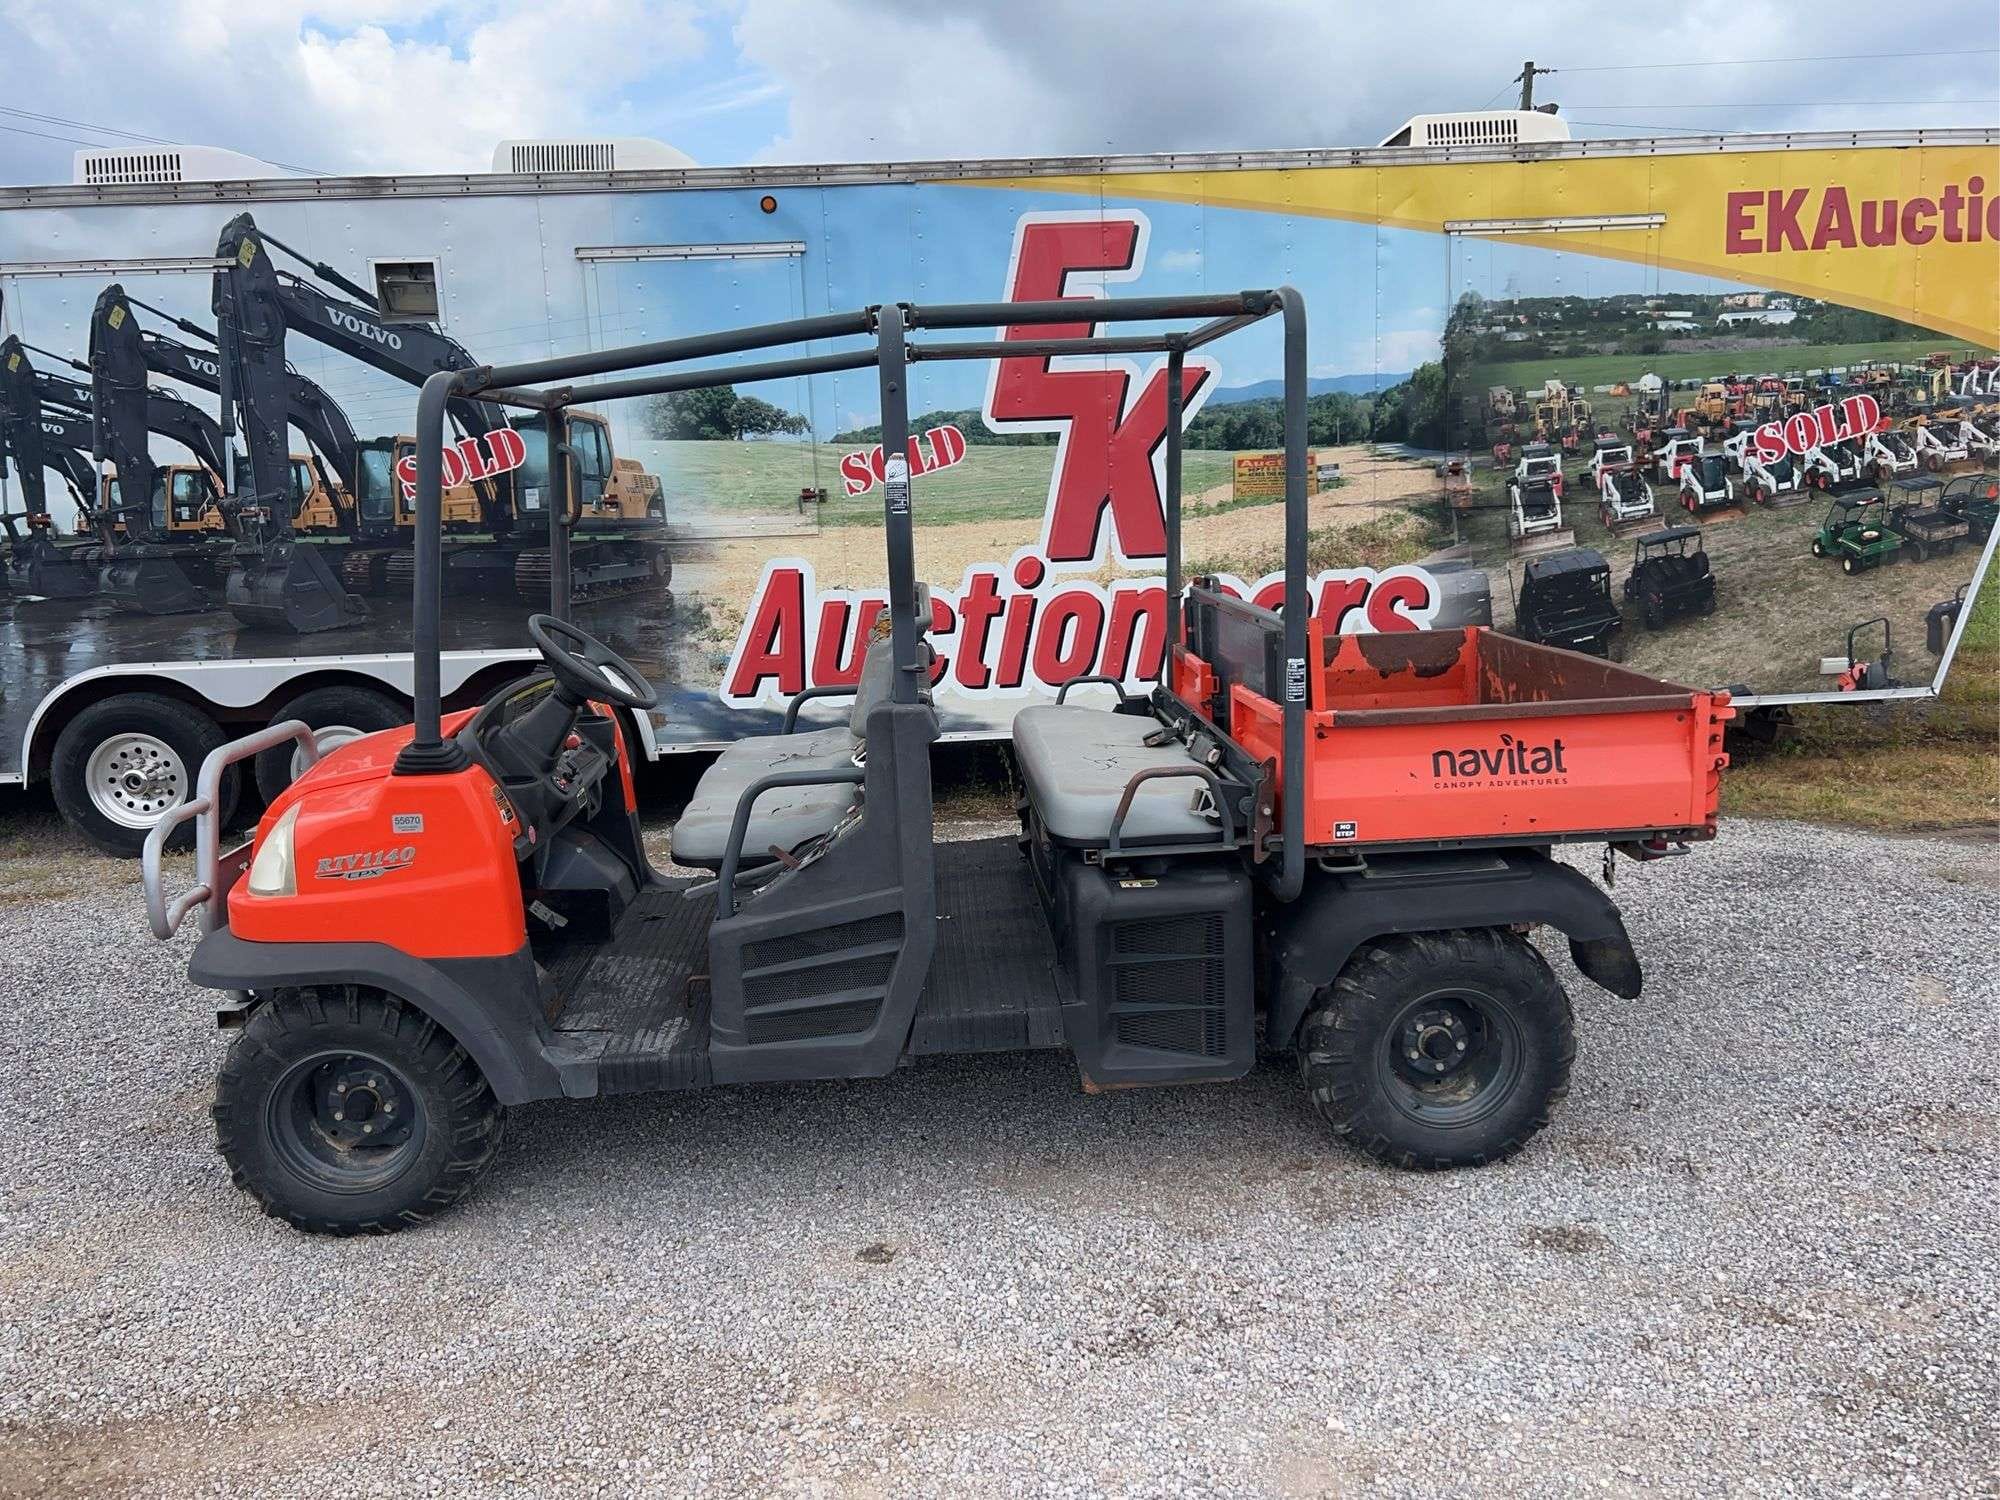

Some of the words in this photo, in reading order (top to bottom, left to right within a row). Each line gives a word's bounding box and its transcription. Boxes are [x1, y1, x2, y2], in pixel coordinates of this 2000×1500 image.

[324, 306, 402, 350] VOLVO
[184, 354, 220, 377] VO
[990, 220, 1211, 562] EK
[1754, 394, 1880, 465] SOLD
[1432, 734, 1567, 777] navitat
[1434, 781, 1482, 789] CANOPY
[1489, 778, 1568, 787] ADVENTURES
[316, 847, 416, 873] RTV1140
